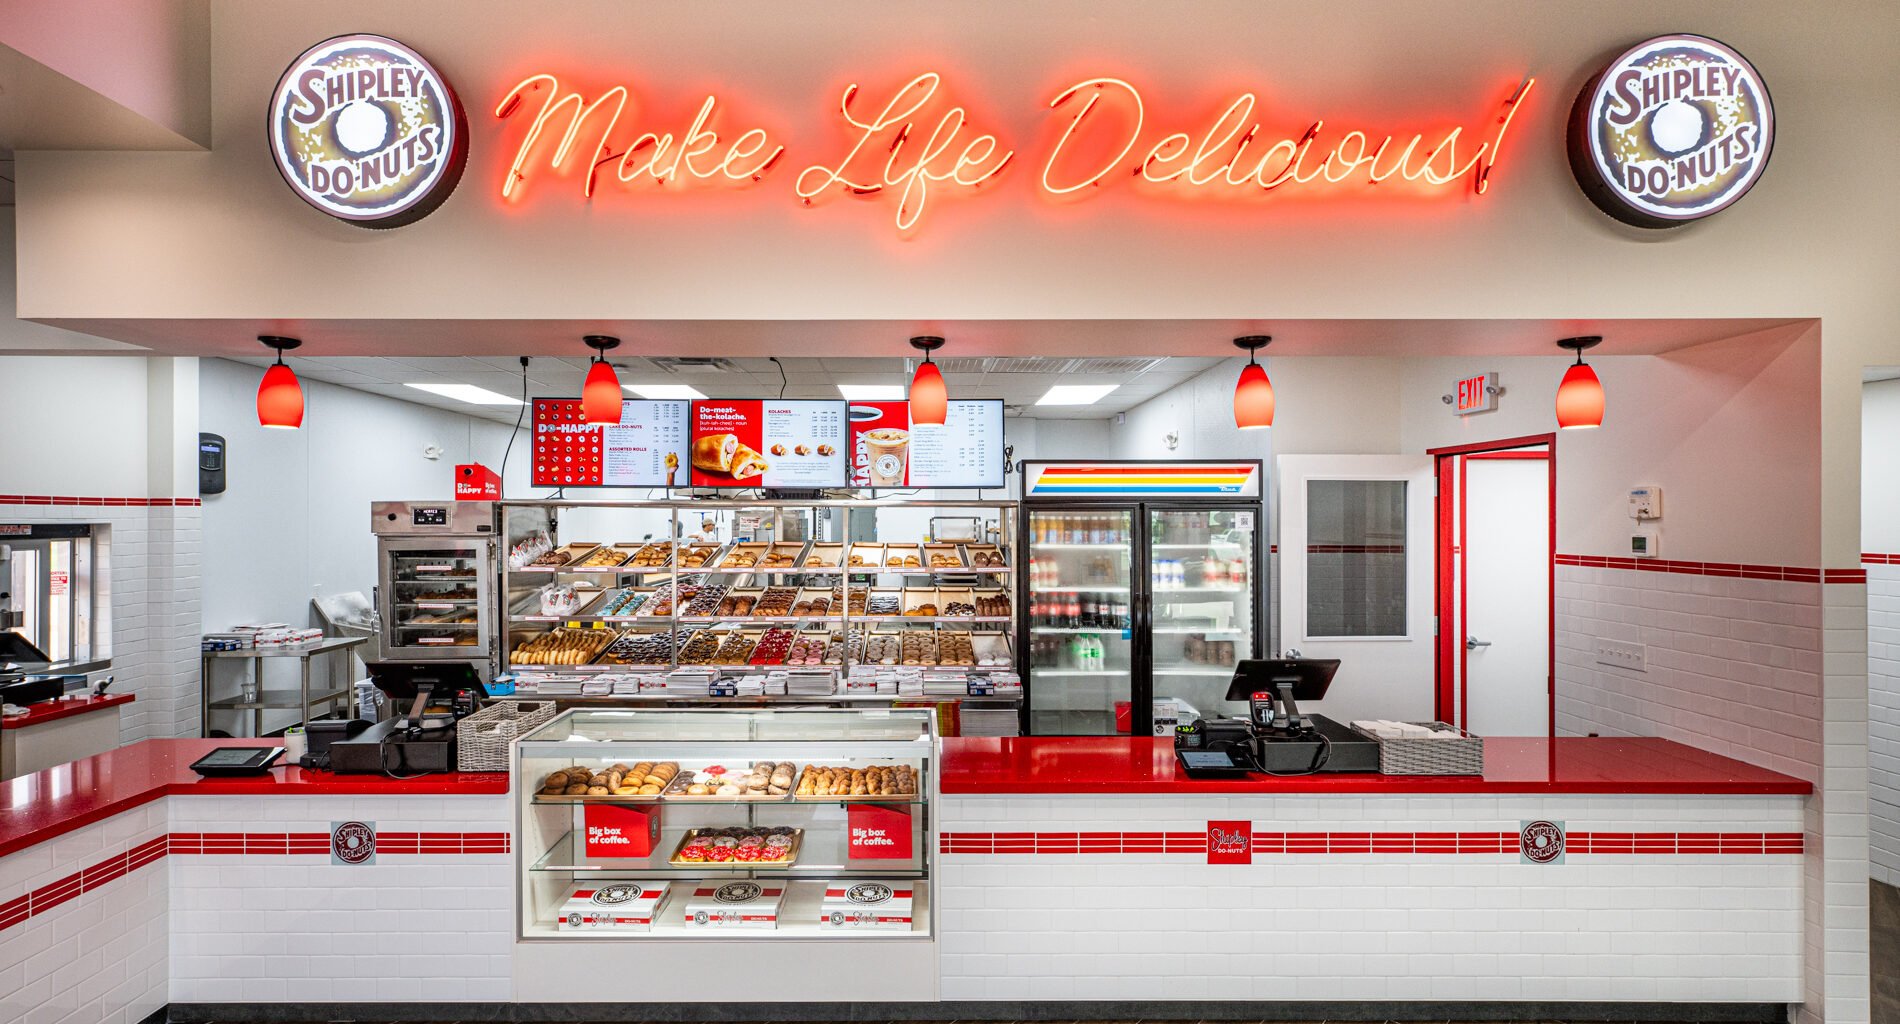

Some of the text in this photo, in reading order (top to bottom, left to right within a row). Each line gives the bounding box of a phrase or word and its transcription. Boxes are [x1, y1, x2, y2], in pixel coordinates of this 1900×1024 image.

[293, 67, 425, 124] SHIPLEY
[1609, 66, 1742, 125] SHIPLEY
[311, 127, 437, 194] DO-NUTS
[495, 72, 1534, 230] Make Life Delicious!
[1627, 125, 1754, 195] DO-NUTS
[1458, 376, 1485, 410] EXIT
[337, 829, 367, 842] SHIPLEY
[589, 827, 621, 837] Big box
[589, 836, 630, 844] of coffee.
[852, 828, 885, 838] Big box
[852, 837, 894, 845] of coffee.
[1210, 827, 1248, 851] Shipley
[1525, 828, 1556, 841] SHIPLEY
